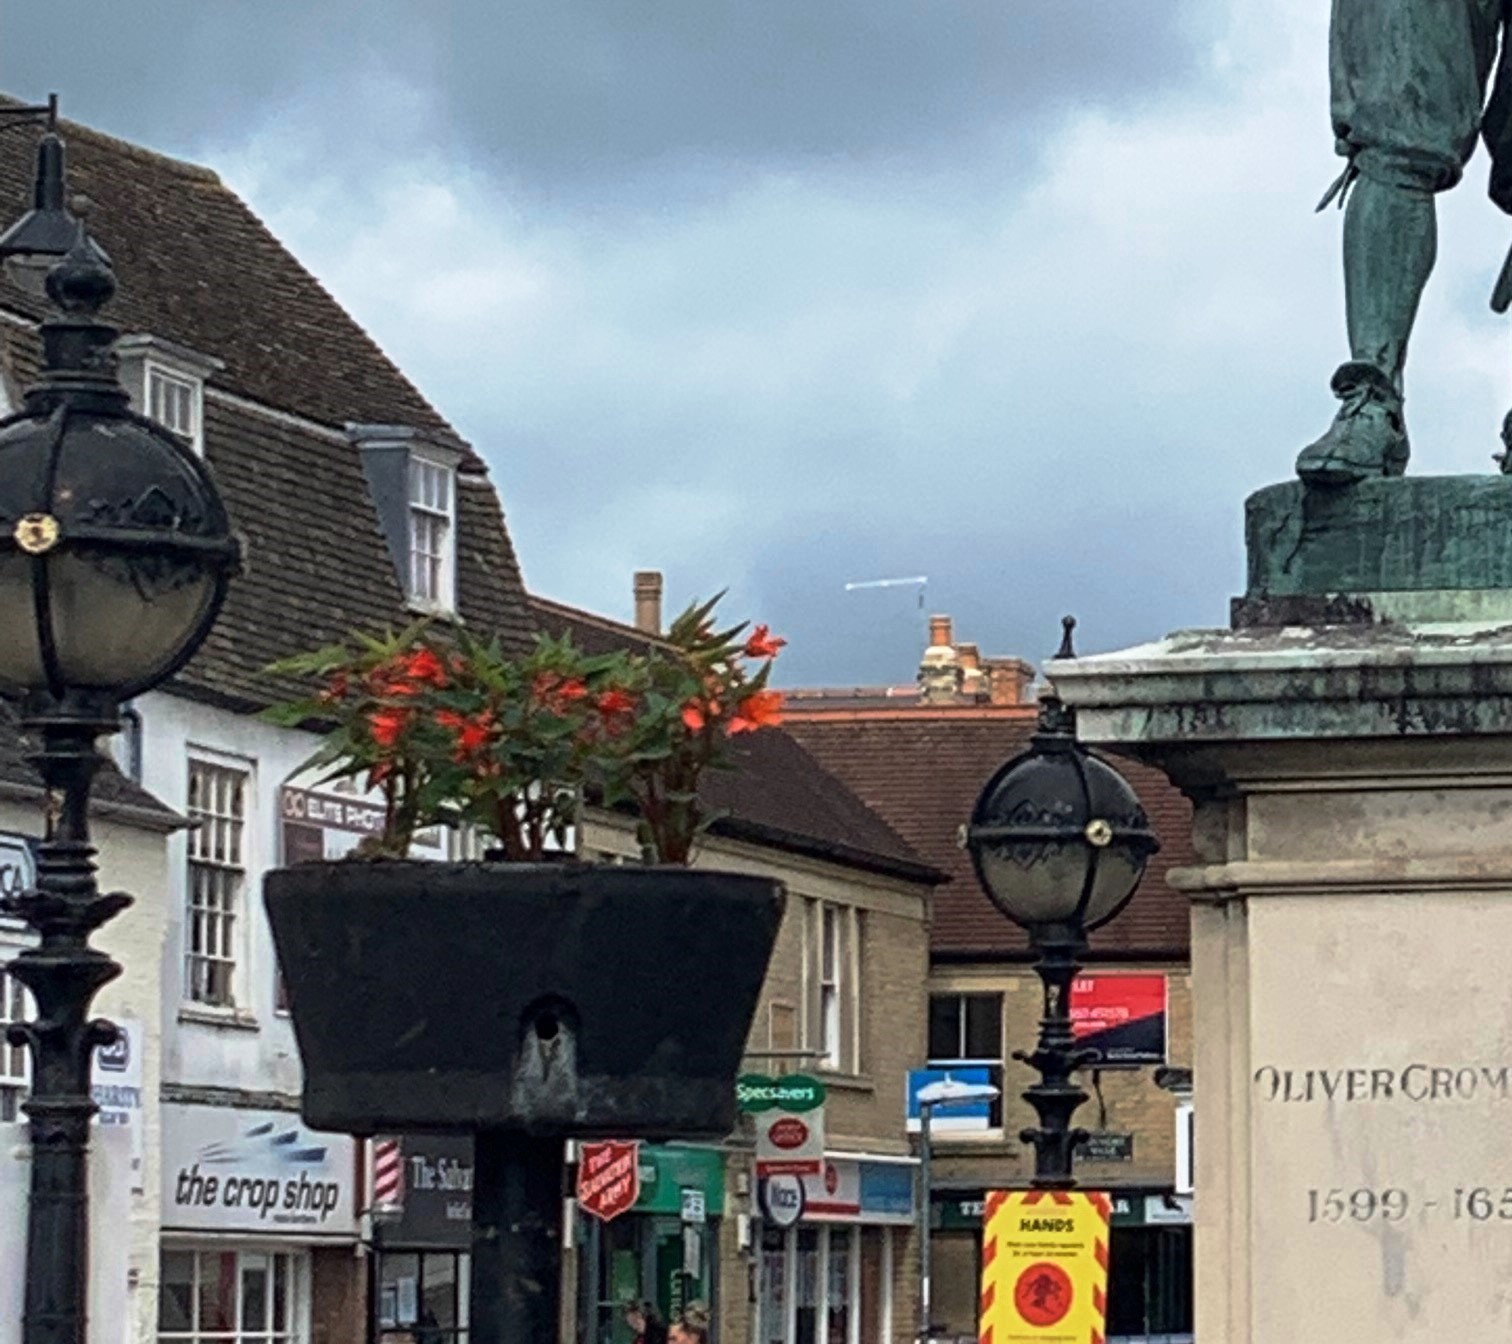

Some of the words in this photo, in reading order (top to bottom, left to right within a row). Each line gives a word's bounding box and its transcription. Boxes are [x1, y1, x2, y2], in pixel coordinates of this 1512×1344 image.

[737, 1083, 815, 1102] Specsavers
[1254, 1064, 1396, 1103] OLIVER
[175, 1163, 219, 1206] the
[223, 1176, 280, 1219] crop
[283, 1169, 339, 1222] shop
[1307, 1187, 1410, 1223] 1599
[1020, 1218, 1075, 1233] HANDS
